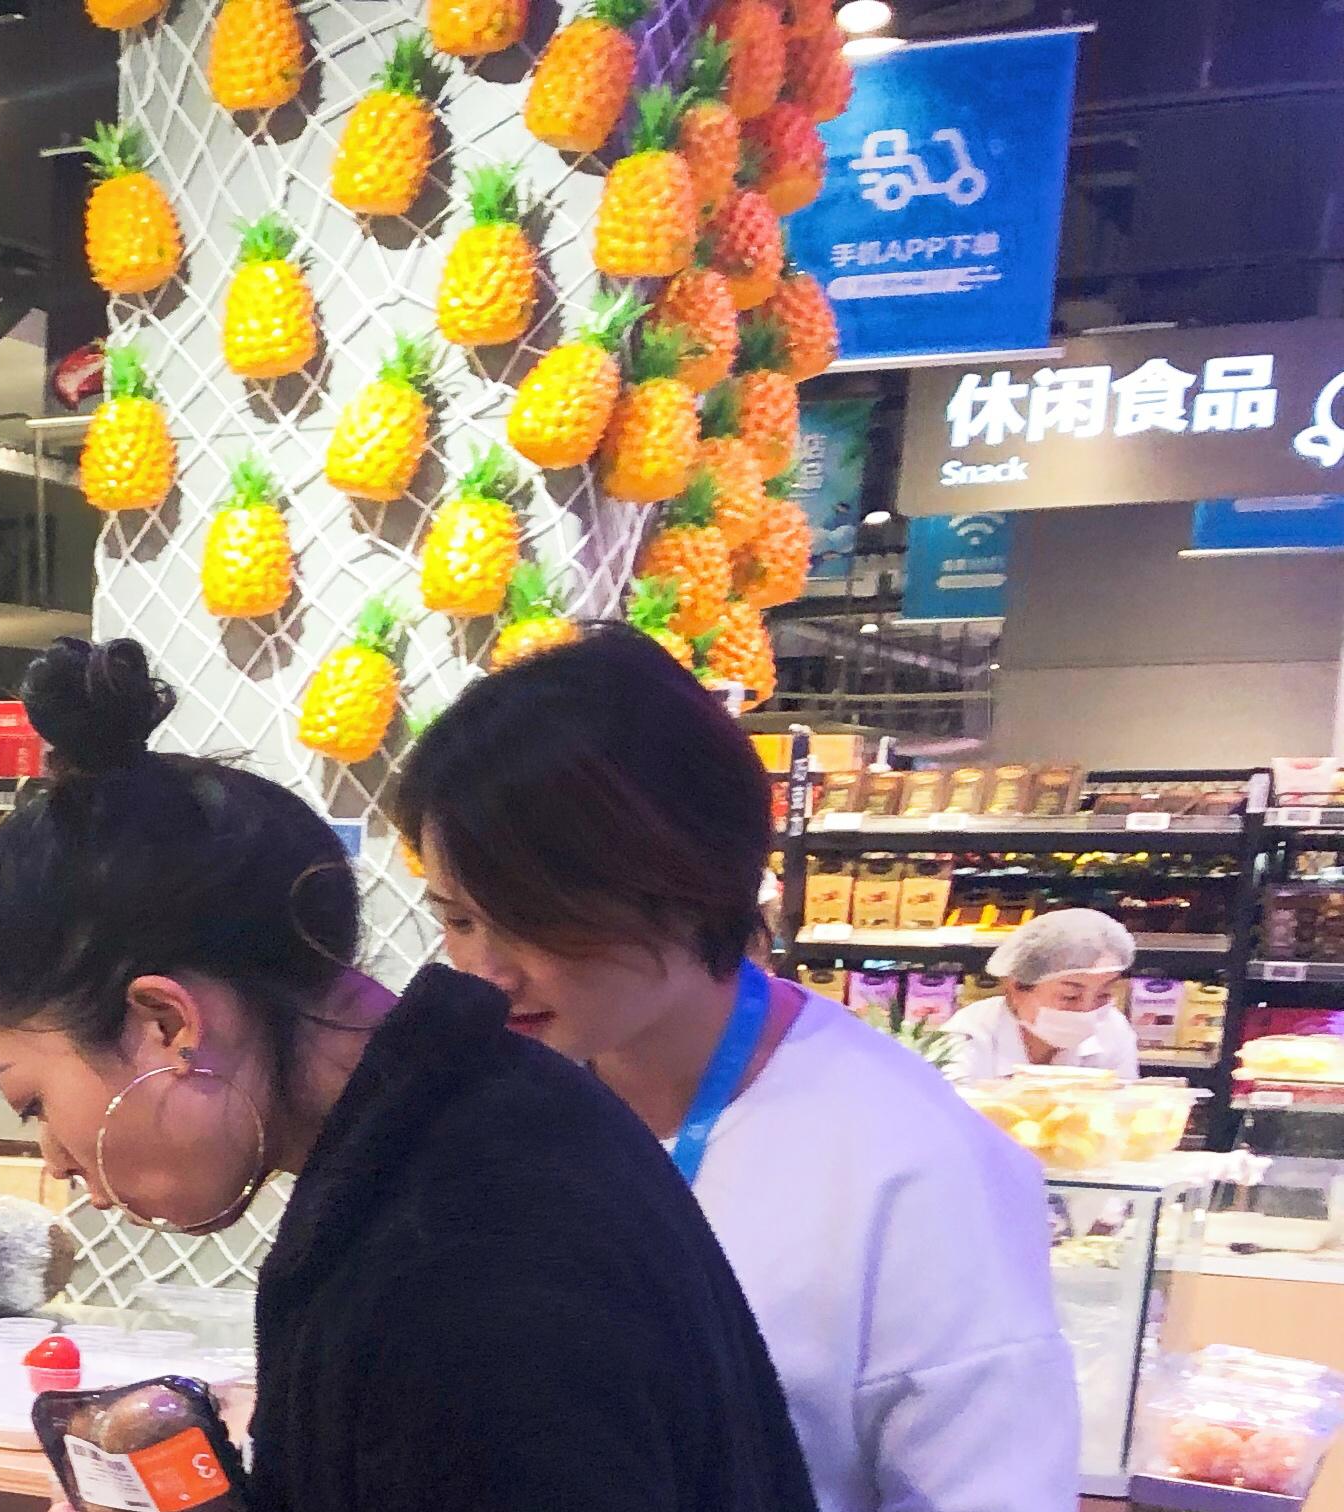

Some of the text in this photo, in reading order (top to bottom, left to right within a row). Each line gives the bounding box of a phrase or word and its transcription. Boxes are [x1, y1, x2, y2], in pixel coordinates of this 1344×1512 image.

[946, 353, 1279, 449] 休闲食品
[939, 458, 1029, 487] Snack
